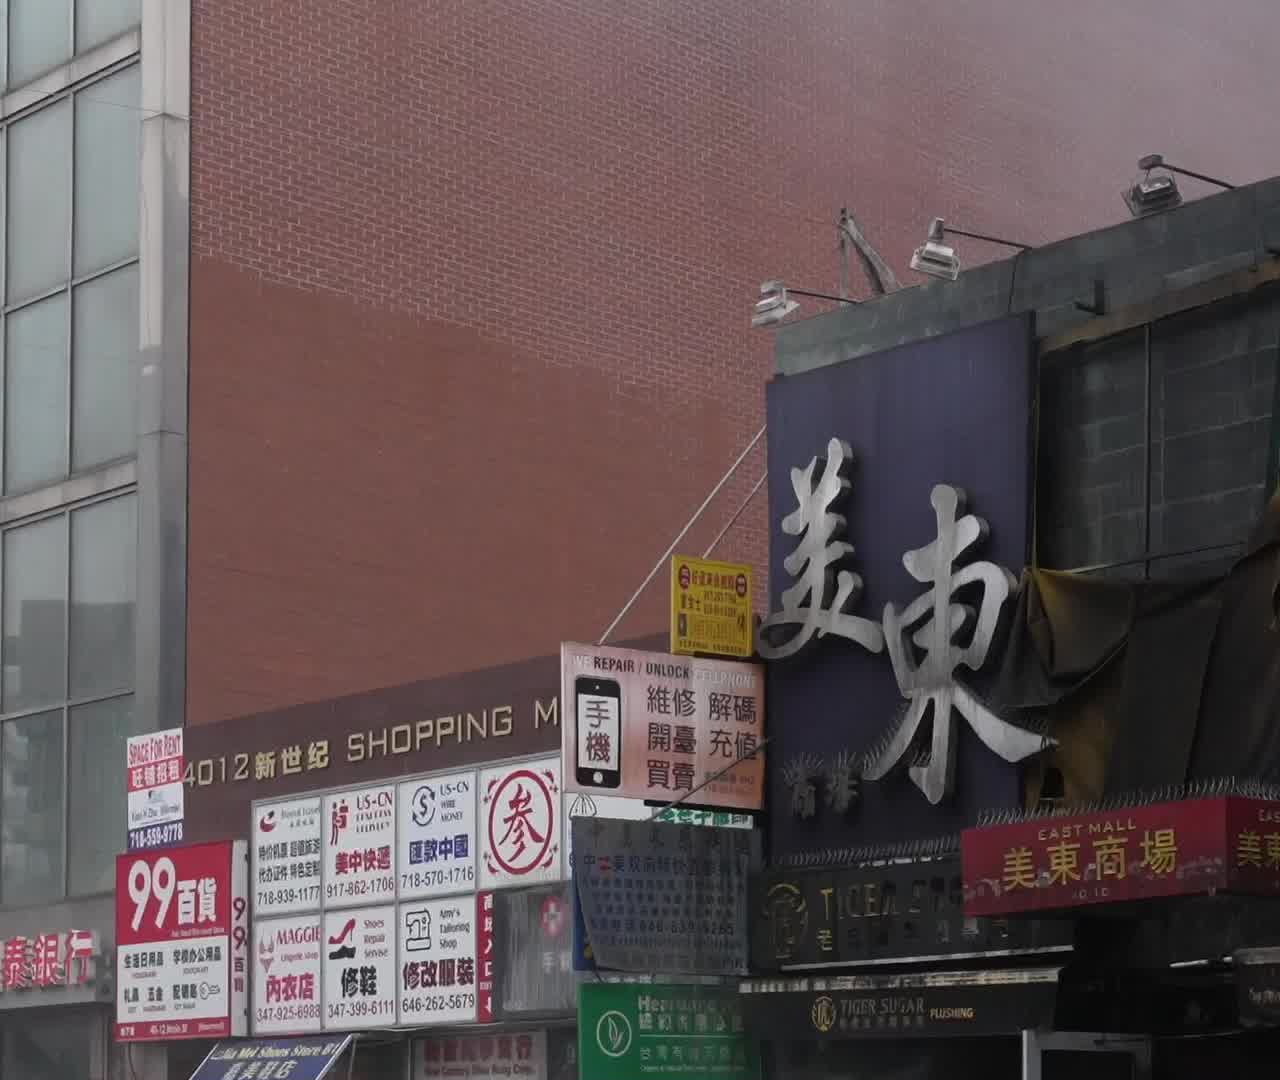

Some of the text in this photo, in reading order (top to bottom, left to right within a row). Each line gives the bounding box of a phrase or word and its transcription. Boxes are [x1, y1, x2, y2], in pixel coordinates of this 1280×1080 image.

[759, 437, 1060, 804] 美東
[594, 657, 635, 673] REPAIR
[646, 662, 690, 679] UNLOCK
[647, 685, 696, 717] 維修
[346, 705, 514, 764] SHOPPING
[586, 700, 611, 763] 手機
[647, 759, 696, 792] 買賣
[356, 791, 393, 810] US-CN
[440, 780, 470, 797] US-CN
[1038, 816, 1137, 841] EAST MALL
[1002, 828, 1179, 892] 美東商場
[326, 876, 394, 898] 917-862-1706
[402, 866, 475, 889] 718-570-1716
[276, 924, 321, 946] MAGGIE
[341, 966, 377, 998] 修鞋
[402, 993, 475, 1014] 646-262-5679
